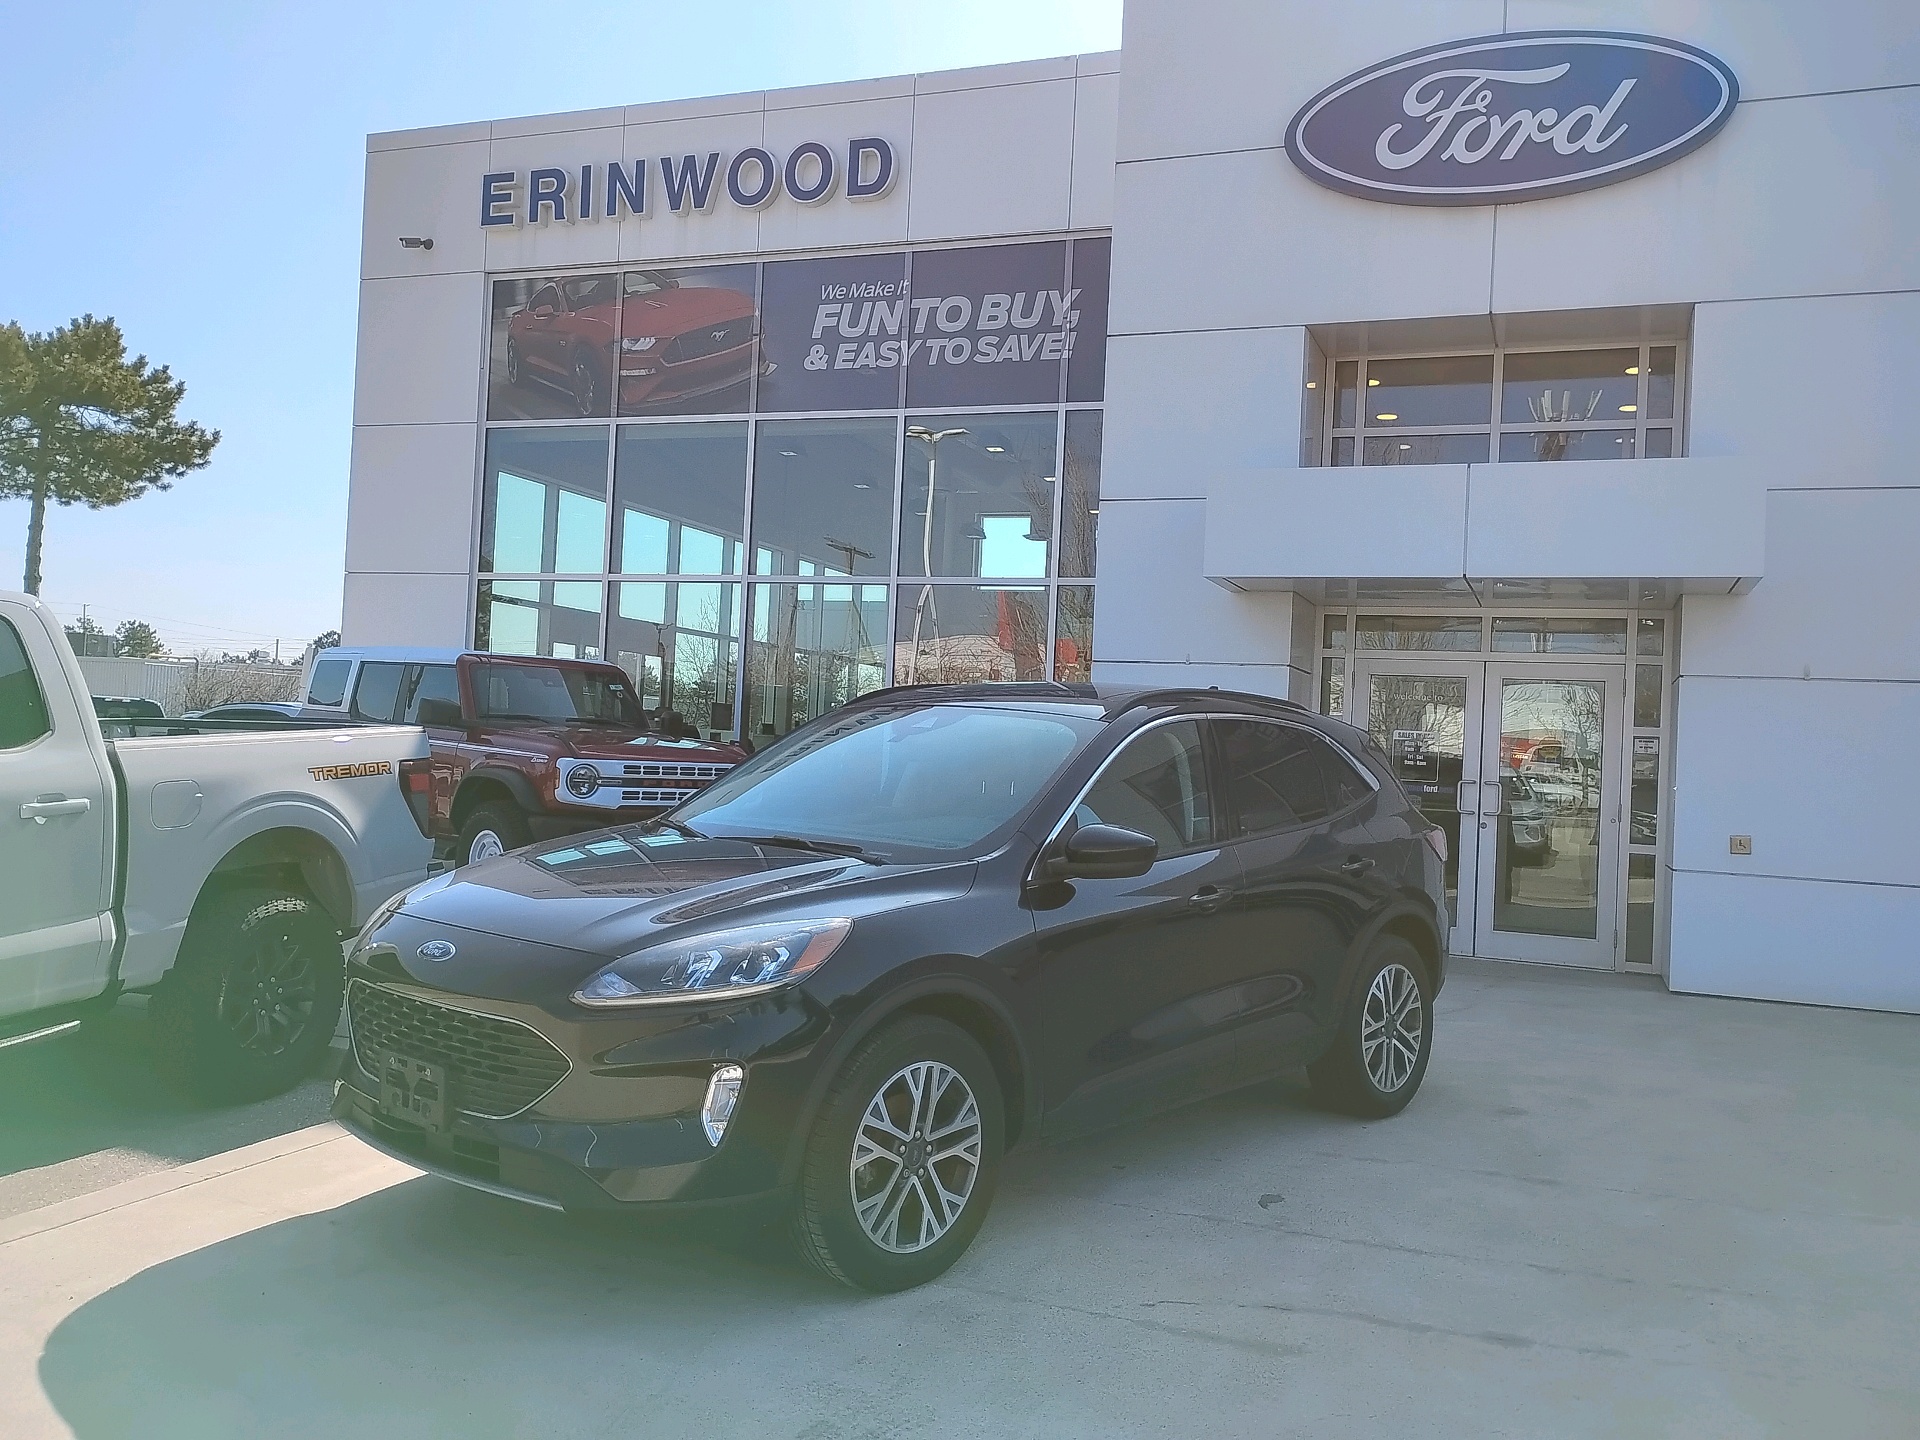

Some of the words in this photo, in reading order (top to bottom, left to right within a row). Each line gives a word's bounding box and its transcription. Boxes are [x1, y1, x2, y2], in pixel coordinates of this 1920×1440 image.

[1375, 62, 1638, 170] Ford
[480, 136, 896, 227] ERINWOOD
[821, 283, 846, 300] We
[848, 281, 895, 298] Make
[811, 299, 904, 338] FUN
[911, 295, 972, 333] TO
[803, 344, 828, 370] &
[834, 340, 923, 369] EASY
[926, 336, 972, 365] TO
[973, 331, 1077, 363] SAVE!
[308, 761, 392, 781] TREMOR
